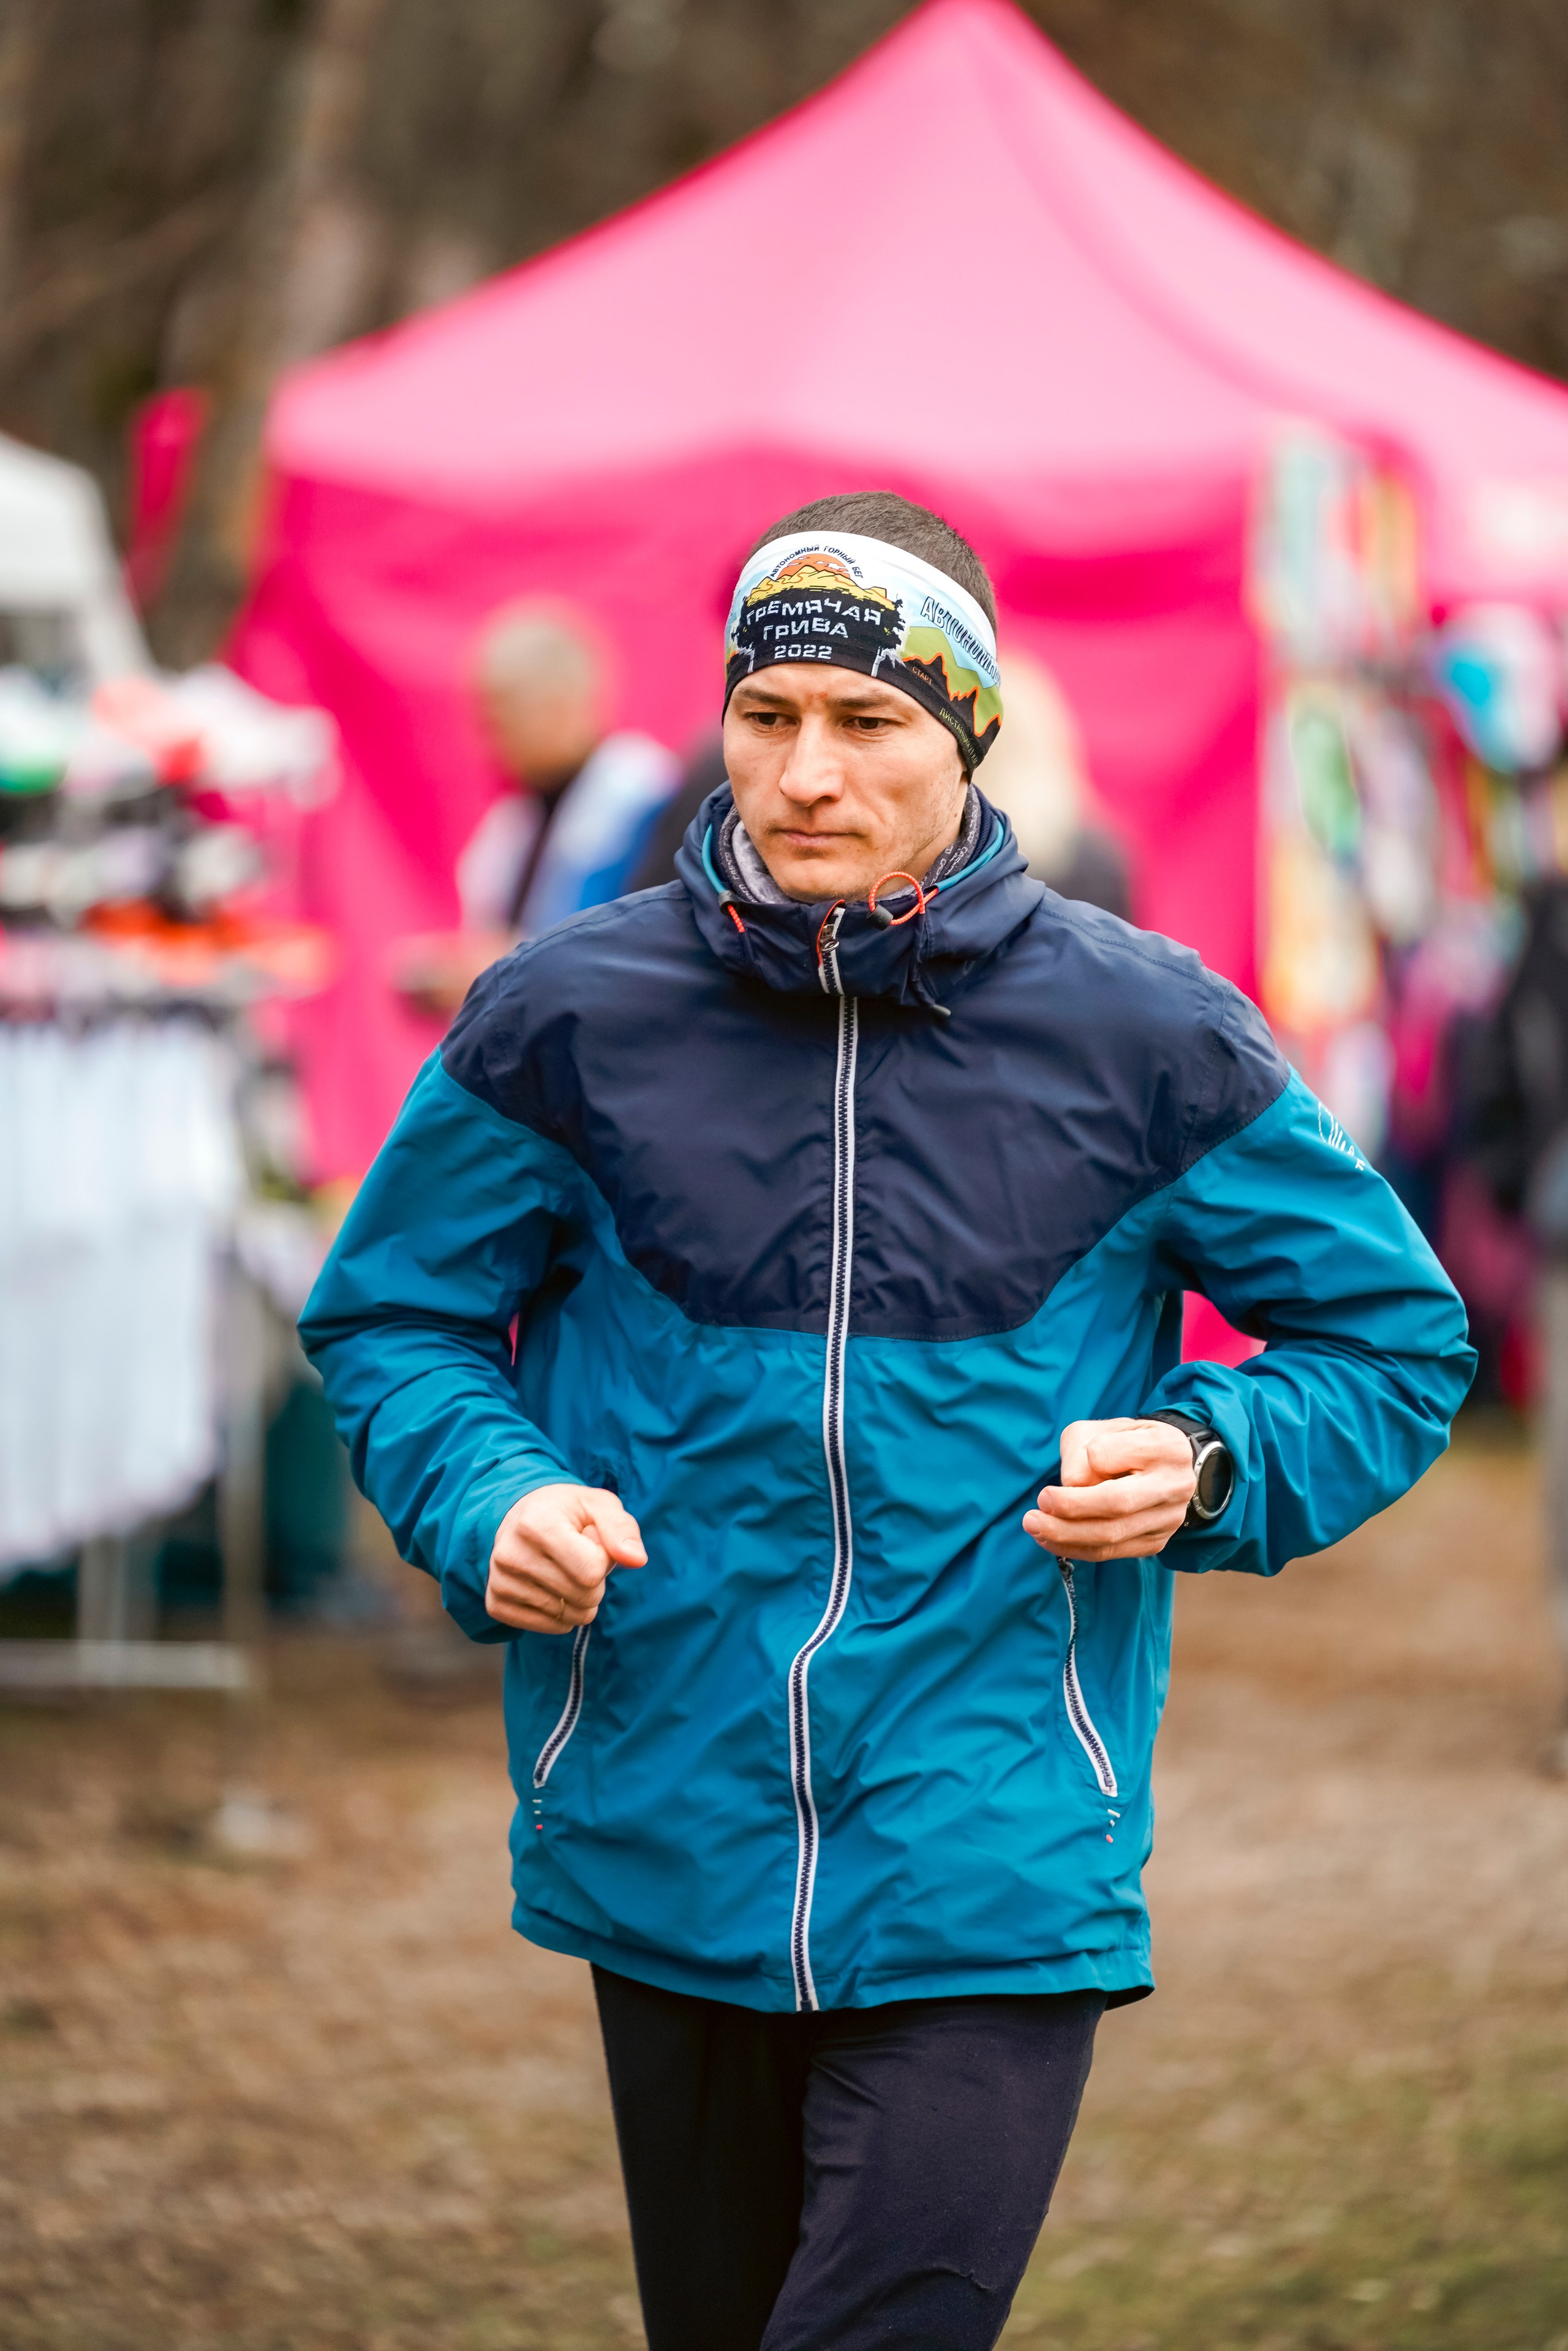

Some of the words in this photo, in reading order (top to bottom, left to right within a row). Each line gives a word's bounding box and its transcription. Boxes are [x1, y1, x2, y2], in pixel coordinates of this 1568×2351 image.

[770, 545, 820, 577] АВТОНОМНЫЙ
[823, 546, 856, 564] ГОРНЫЙ
[851, 566, 864, 579] БЕГ
[746, 598, 882, 625] ГРЕМЯЧАЯ
[763, 617, 849, 641] ГРИВА
[774, 644, 832, 660] 2022
[912, 666, 933, 685] СТАРТ
